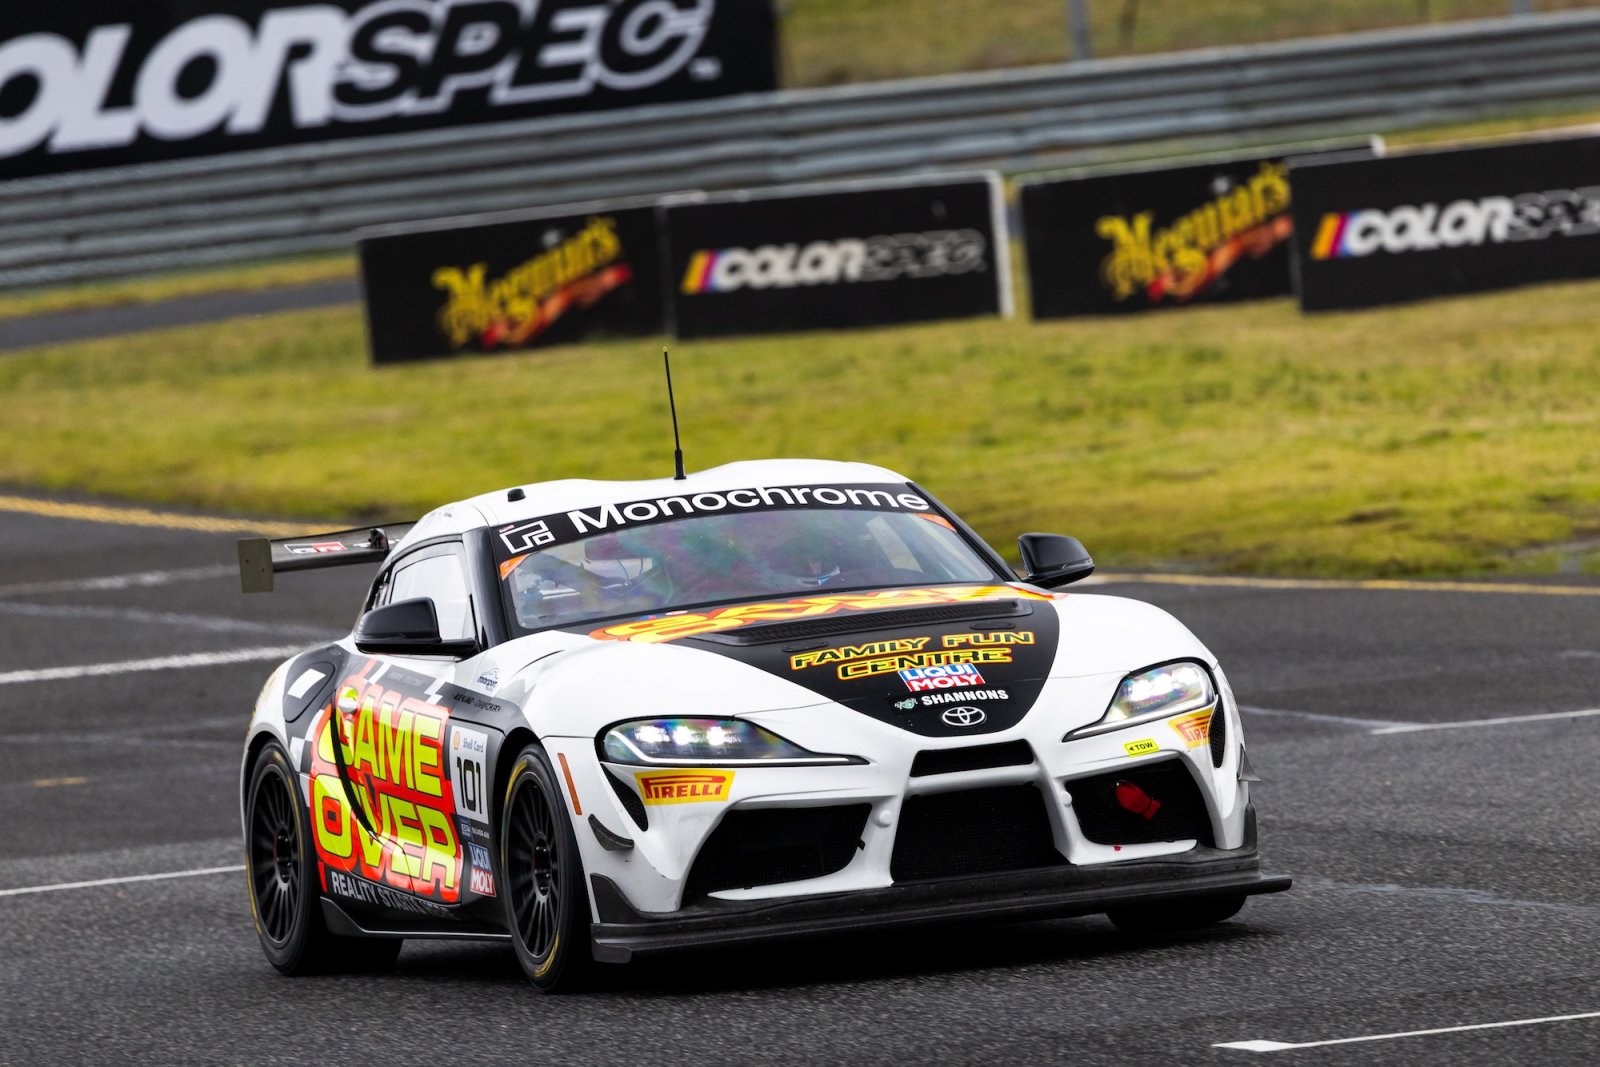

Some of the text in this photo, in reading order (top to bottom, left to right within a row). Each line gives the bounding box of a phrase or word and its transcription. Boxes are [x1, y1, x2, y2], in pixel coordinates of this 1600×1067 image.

[566, 486, 930, 534] Monochrome
[791, 632, 1034, 669] FAMILY FUN
[838, 648, 1012, 680] CENTRE
[903, 664, 975, 681] LIQUI
[909, 674, 979, 692] MOLY
[921, 689, 1009, 706] SHANNONS
[318, 692, 444, 798] GAME
[1134, 741, 1154, 751] TOW
[457, 756, 482, 815] 101
[641, 775, 726, 799] PIRELLI
[313, 773, 458, 889] OVER
[331, 871, 379, 905] REALITY
[471, 869, 495, 896] MOLY
